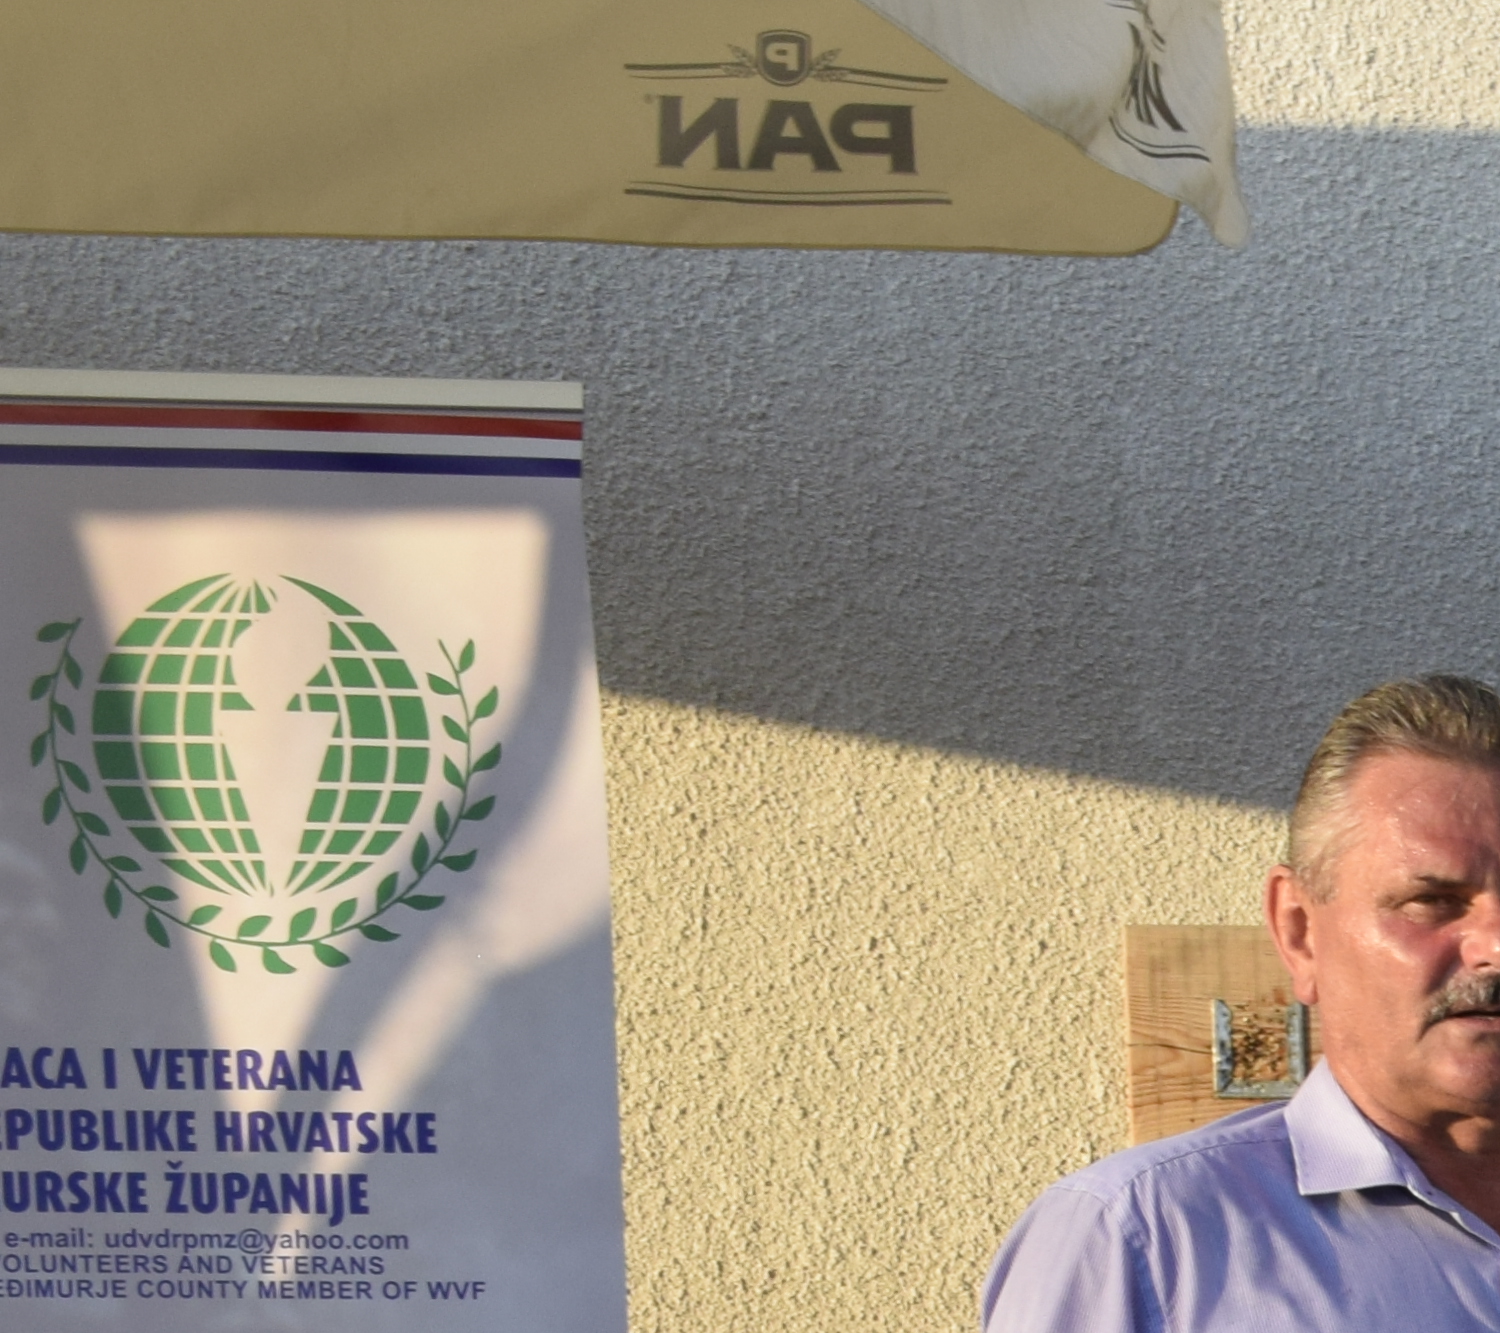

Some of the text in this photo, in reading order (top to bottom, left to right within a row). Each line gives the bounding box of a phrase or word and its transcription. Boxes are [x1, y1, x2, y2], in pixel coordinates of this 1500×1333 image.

[1, 1047, 362, 1091] ACA I VETERANA
[0, 1108, 437, 1154] PUBLIKE HRVATSKE
[1, 1160, 370, 1227] URSKE ŽUPANIJE
[4, 1228, 410, 1255] e-mail: udvdrpmz@yahoo.com
[177, 1255, 233, 1275] AND
[241, 1255, 385, 1276] VETERANS
[137, 1279, 248, 1300] COUNTY
[258, 1280, 373, 1300] MEMBER
[382, 1282, 419, 1300] OF
[429, 1282, 487, 1301] WVF
